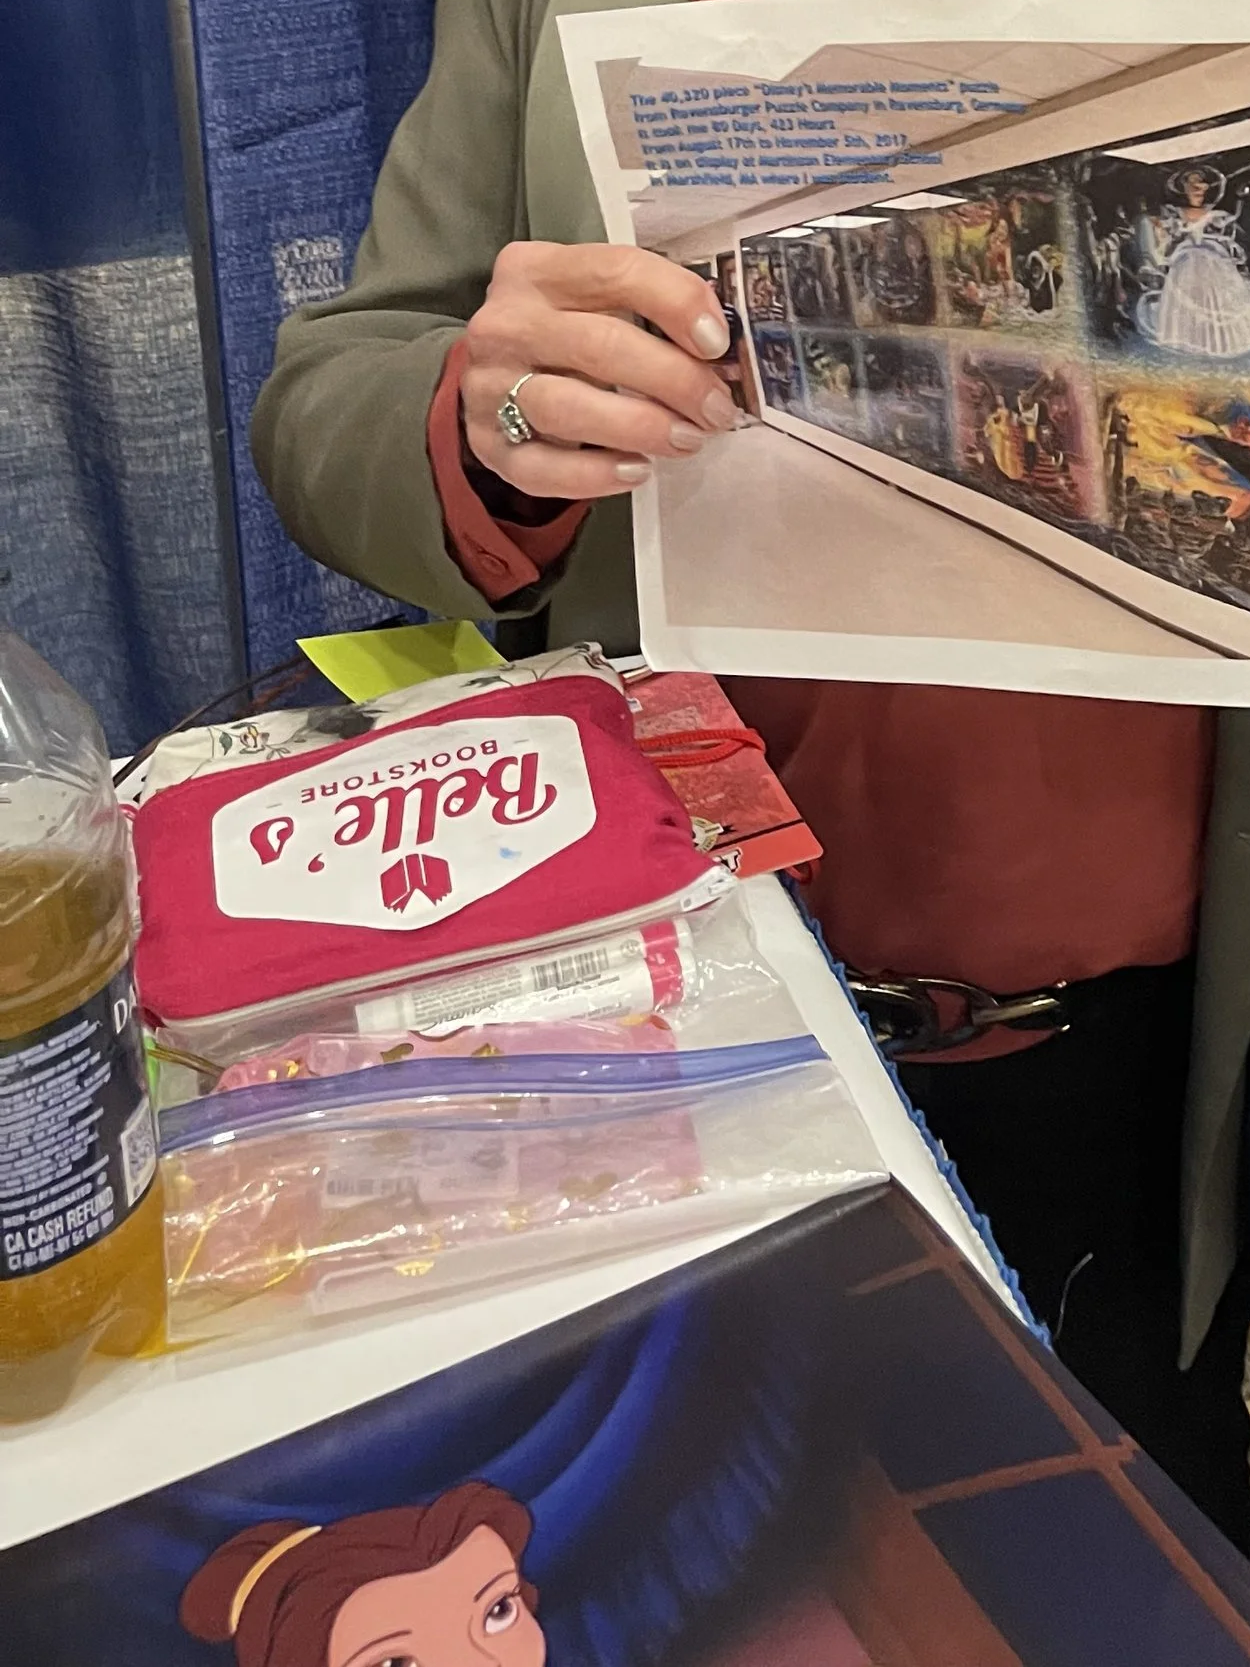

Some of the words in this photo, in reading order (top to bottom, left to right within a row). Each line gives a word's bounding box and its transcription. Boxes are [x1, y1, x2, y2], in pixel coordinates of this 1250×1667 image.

[630, 93, 656, 106] The
[713, 86, 749, 100] piece
[300, 739, 498, 804] BOOKSTORE
[249, 752, 558, 873] Belle's
[4, 1232, 26, 1254] CA
[28, 1215, 64, 1248] CASH
